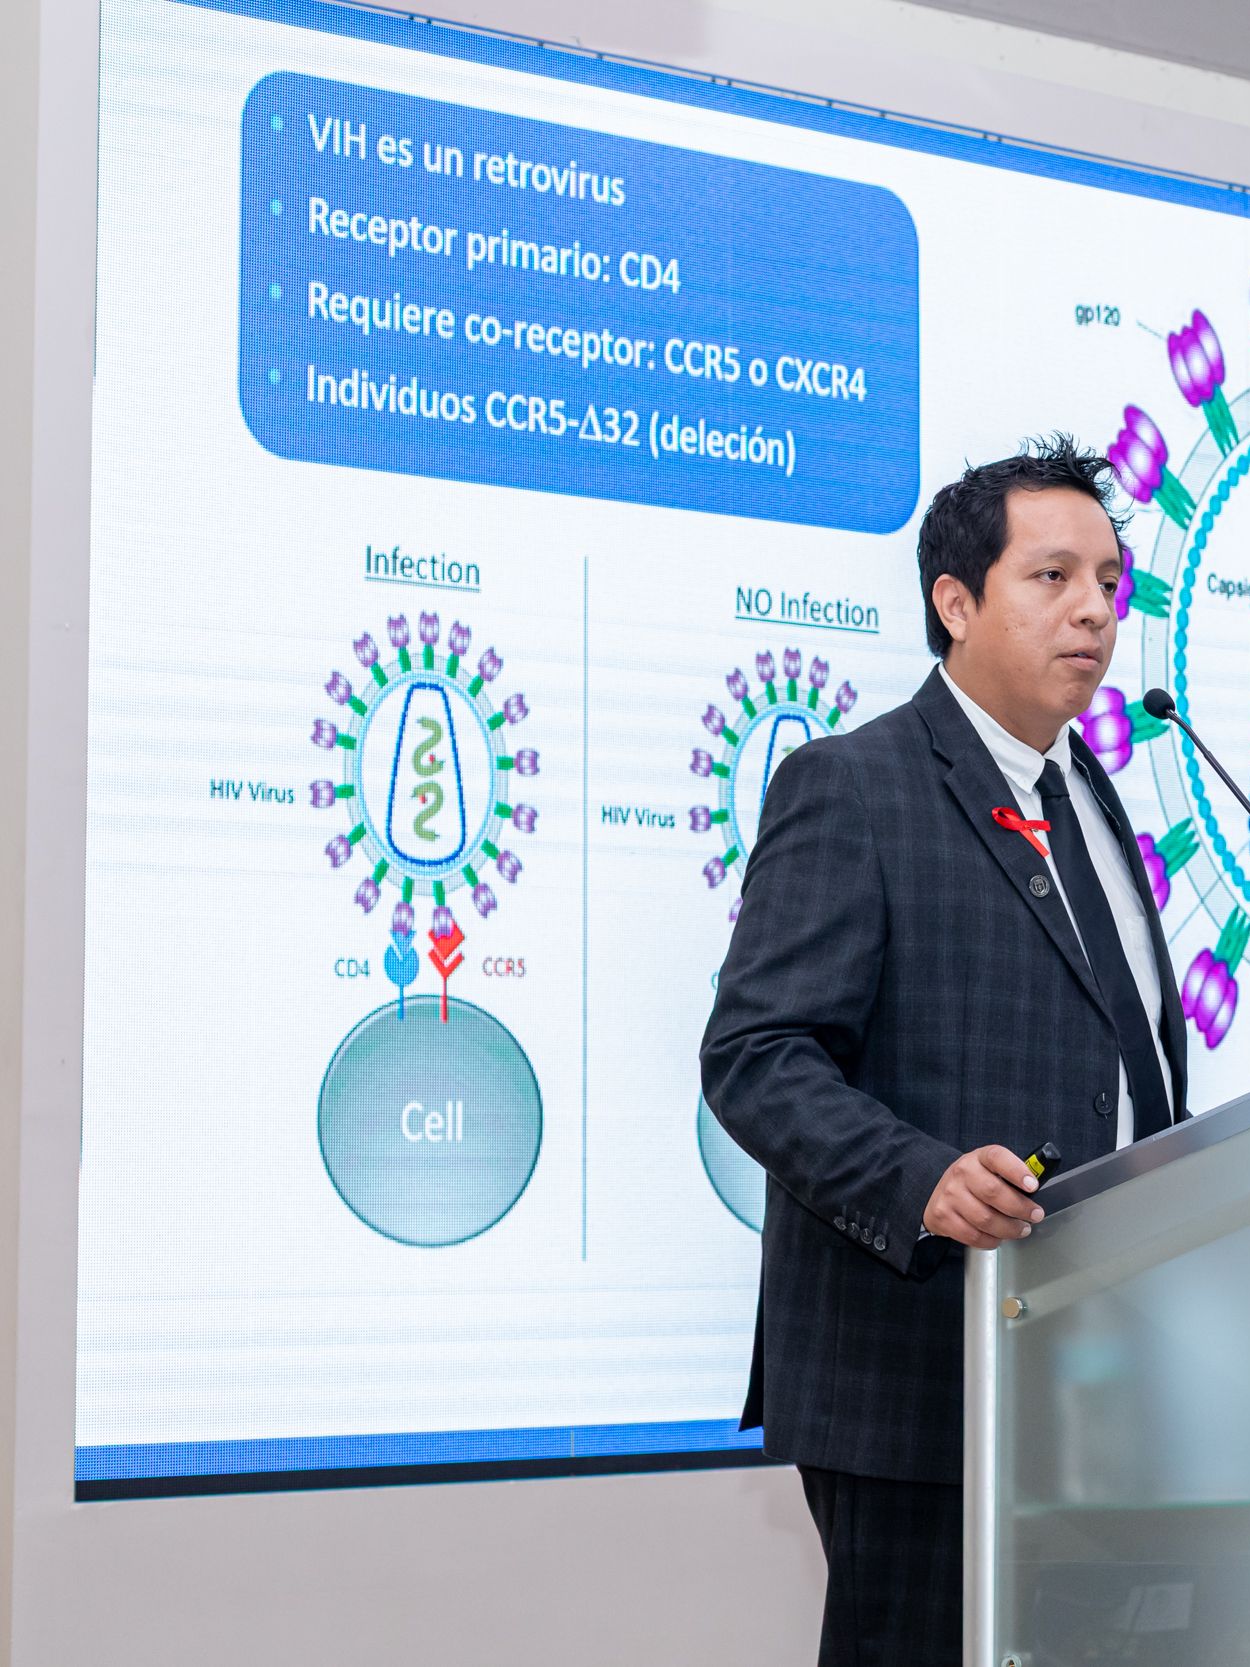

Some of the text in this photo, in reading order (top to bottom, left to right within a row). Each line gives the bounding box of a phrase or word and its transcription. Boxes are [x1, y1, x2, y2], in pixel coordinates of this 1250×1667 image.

[308, 113, 625, 205] VIH es un retrovirus
[309, 197, 680, 293] Receptor primario: CD4
[1075, 304, 1120, 329] gp120
[309, 282, 867, 403] Requiere co-receptor: CCR5 o CXCR4
[307, 365, 476, 424] Individuos
[649, 411, 795, 476] (deleción)
[366, 545, 480, 585] Infection
[736, 586, 880, 629] NO Infection
[210, 780, 295, 804] HIV Virus
[601, 807, 676, 829] HIV Virus
[334, 958, 370, 978] CD4
[483, 958, 526, 978] CCR5
[402, 1101, 463, 1142] Cell
